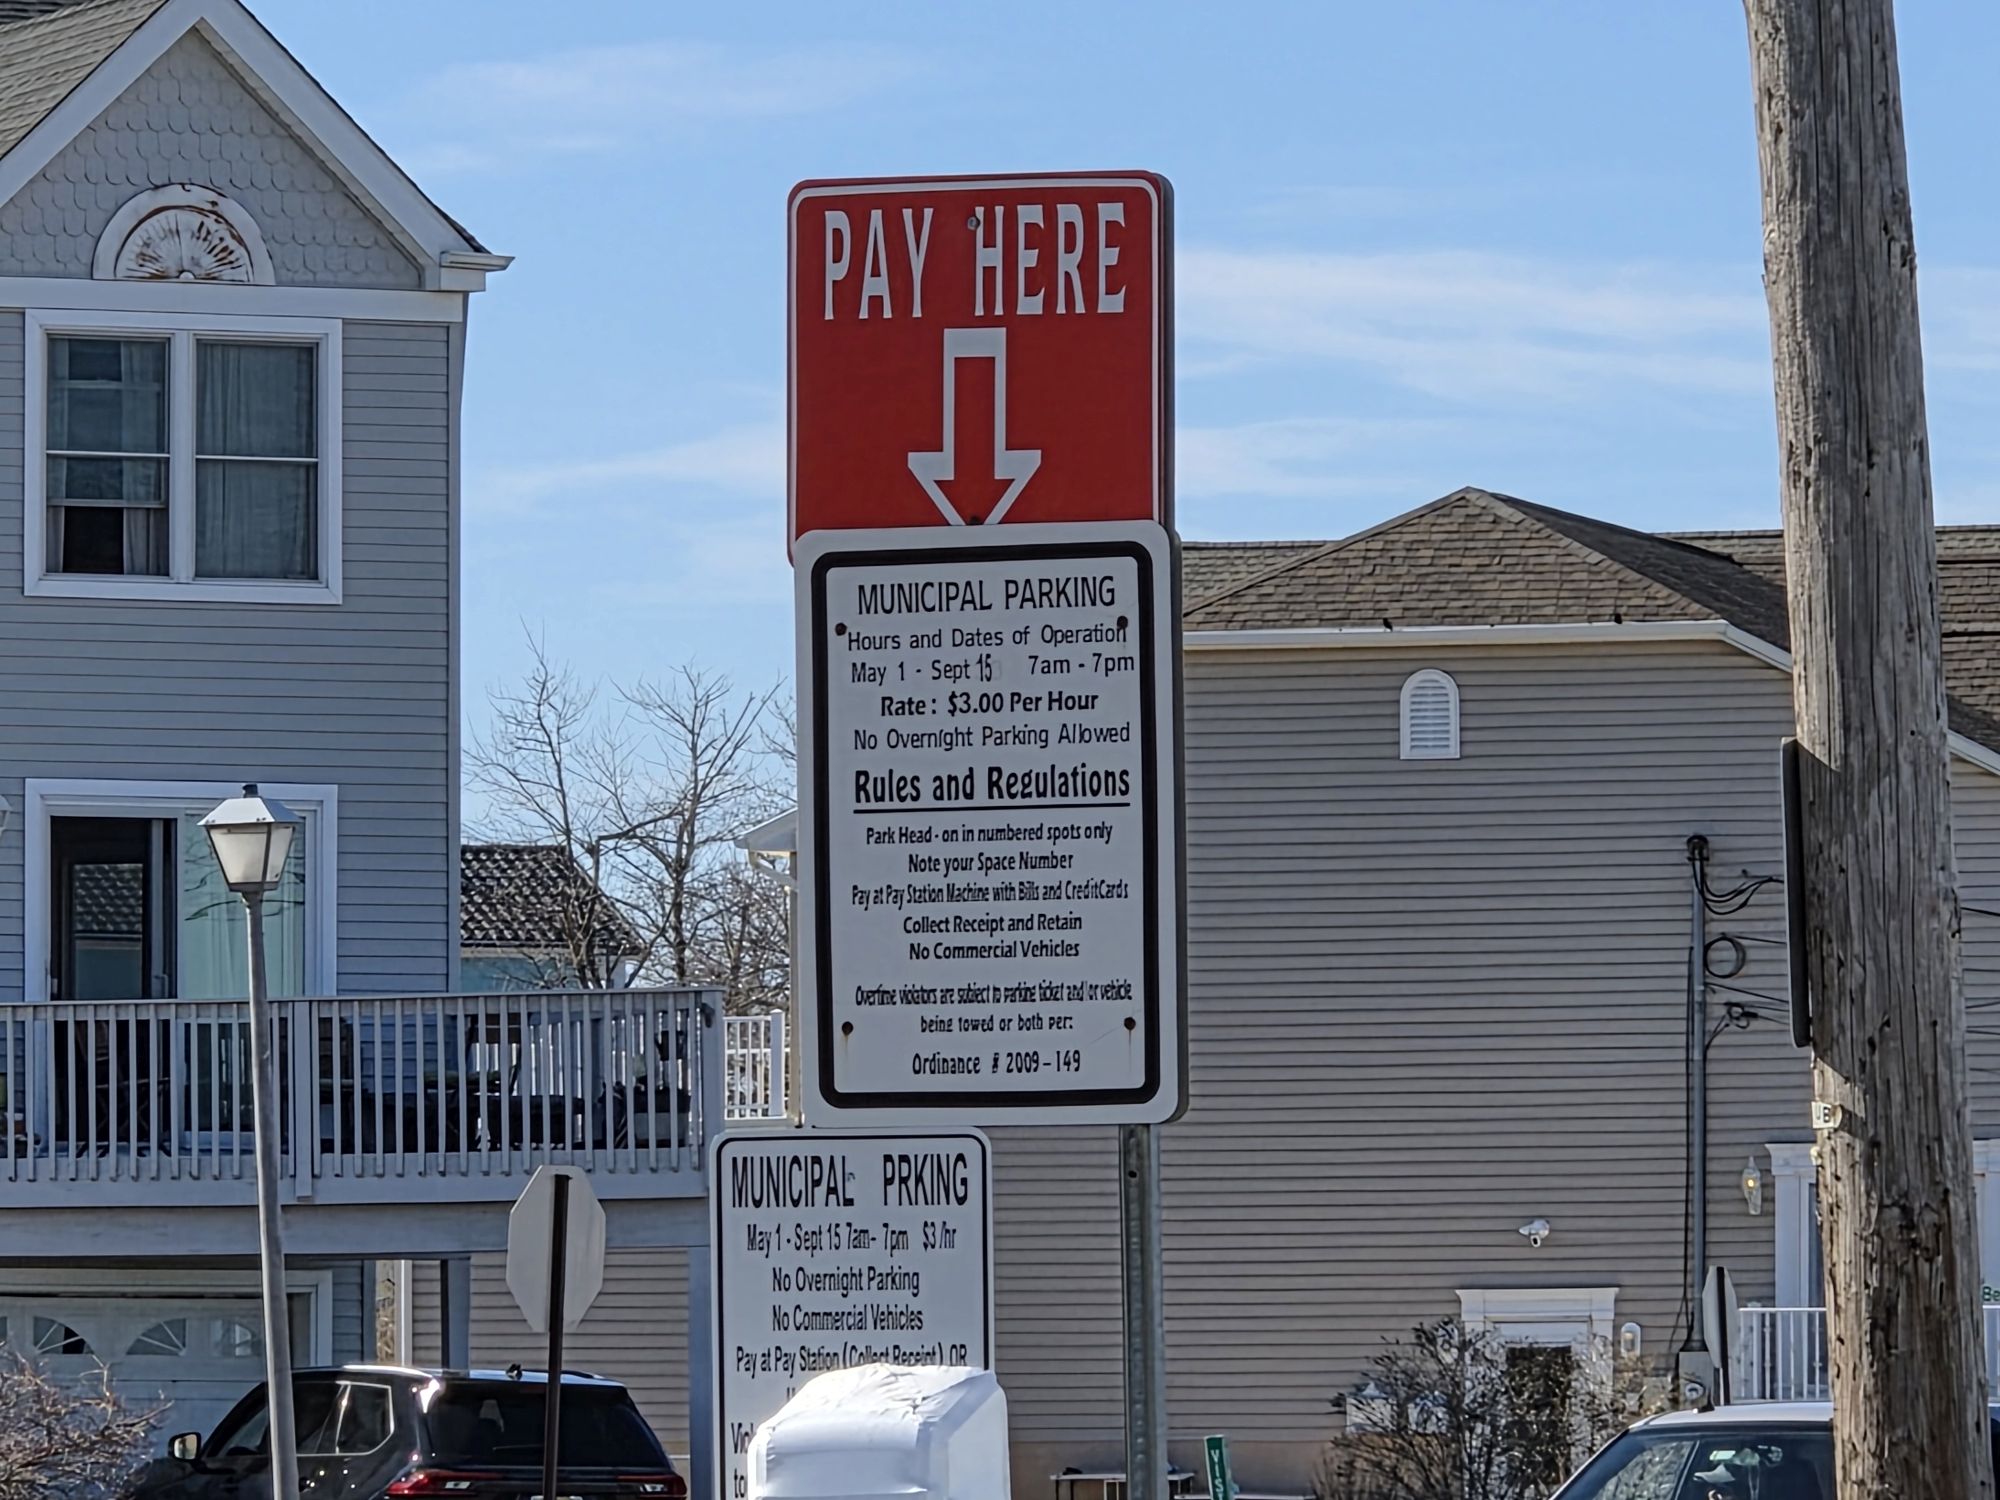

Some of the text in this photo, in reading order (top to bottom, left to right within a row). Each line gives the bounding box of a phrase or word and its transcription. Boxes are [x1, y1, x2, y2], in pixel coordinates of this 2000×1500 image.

[824, 202, 1126, 321] PAY HERE
[858, 575, 1116, 615] MUNICIPAL PARKING
[848, 623, 1127, 651] Hours and Dates of Operation
[851, 662, 886, 686] May
[899, 661, 905, 681] 1
[931, 658, 970, 684] Sept
[976, 653, 993, 682] 15
[1028, 655, 1070, 675] 7am
[1093, 653, 1134, 677] 7pm
[947, 691, 1004, 717] $3.00
[1010, 692, 1043, 712] Per
[1048, 691, 1099, 711] Hour
[854, 721, 1130, 751] No Overnight Parking Allowed
[855, 763, 1130, 804] Rules and Regulations
[866, 827, 896, 844] Park
[962, 824, 975, 842] in
[977, 822, 1044, 842] numbered
[1046, 824, 1081, 846] spots
[1084, 822, 1113, 844] only
[908, 851, 1074, 878] Note your Space Number
[852, 885, 870, 910] Pay
[873, 887, 884, 904] at
[886, 884, 904, 910] Pay
[907, 884, 944, 904] Station
[946, 881, 990, 902] Machine
[992, 880, 1016, 902] with
[1018, 880, 1040, 900] Bills
[1042, 880, 1062, 900] and
[903, 912, 1082, 938] Collect Receipt and Retain
[909, 940, 1080, 960] No Commercial Vehicles
[920, 1015, 953, 1033] being
[958, 1014, 994, 1032] towed
[1000, 1017, 1011, 1031] or
[1018, 1013, 1044, 1031] both
[912, 1052, 980, 1075] Ordinance
[731, 1153, 968, 1209] MUNICIPAL PRKING
[747, 1224, 772, 1259] May
[776, 1224, 781, 1251] 1
[794, 1224, 823, 1258] Sept
[827, 1223, 840, 1250] 15
[883, 1223, 909, 1258] 7pm
[773, 1266, 920, 1298] No Overnight Parking
[773, 1305, 923, 1331] No Commercial Vehicles
[737, 1346, 757, 1379] Pay
[760, 1347, 772, 1372] at
[774, 1346, 795, 1378] Pay
[800, 1345, 840, 1371] Station
[949, 1345, 967, 1366] OR
